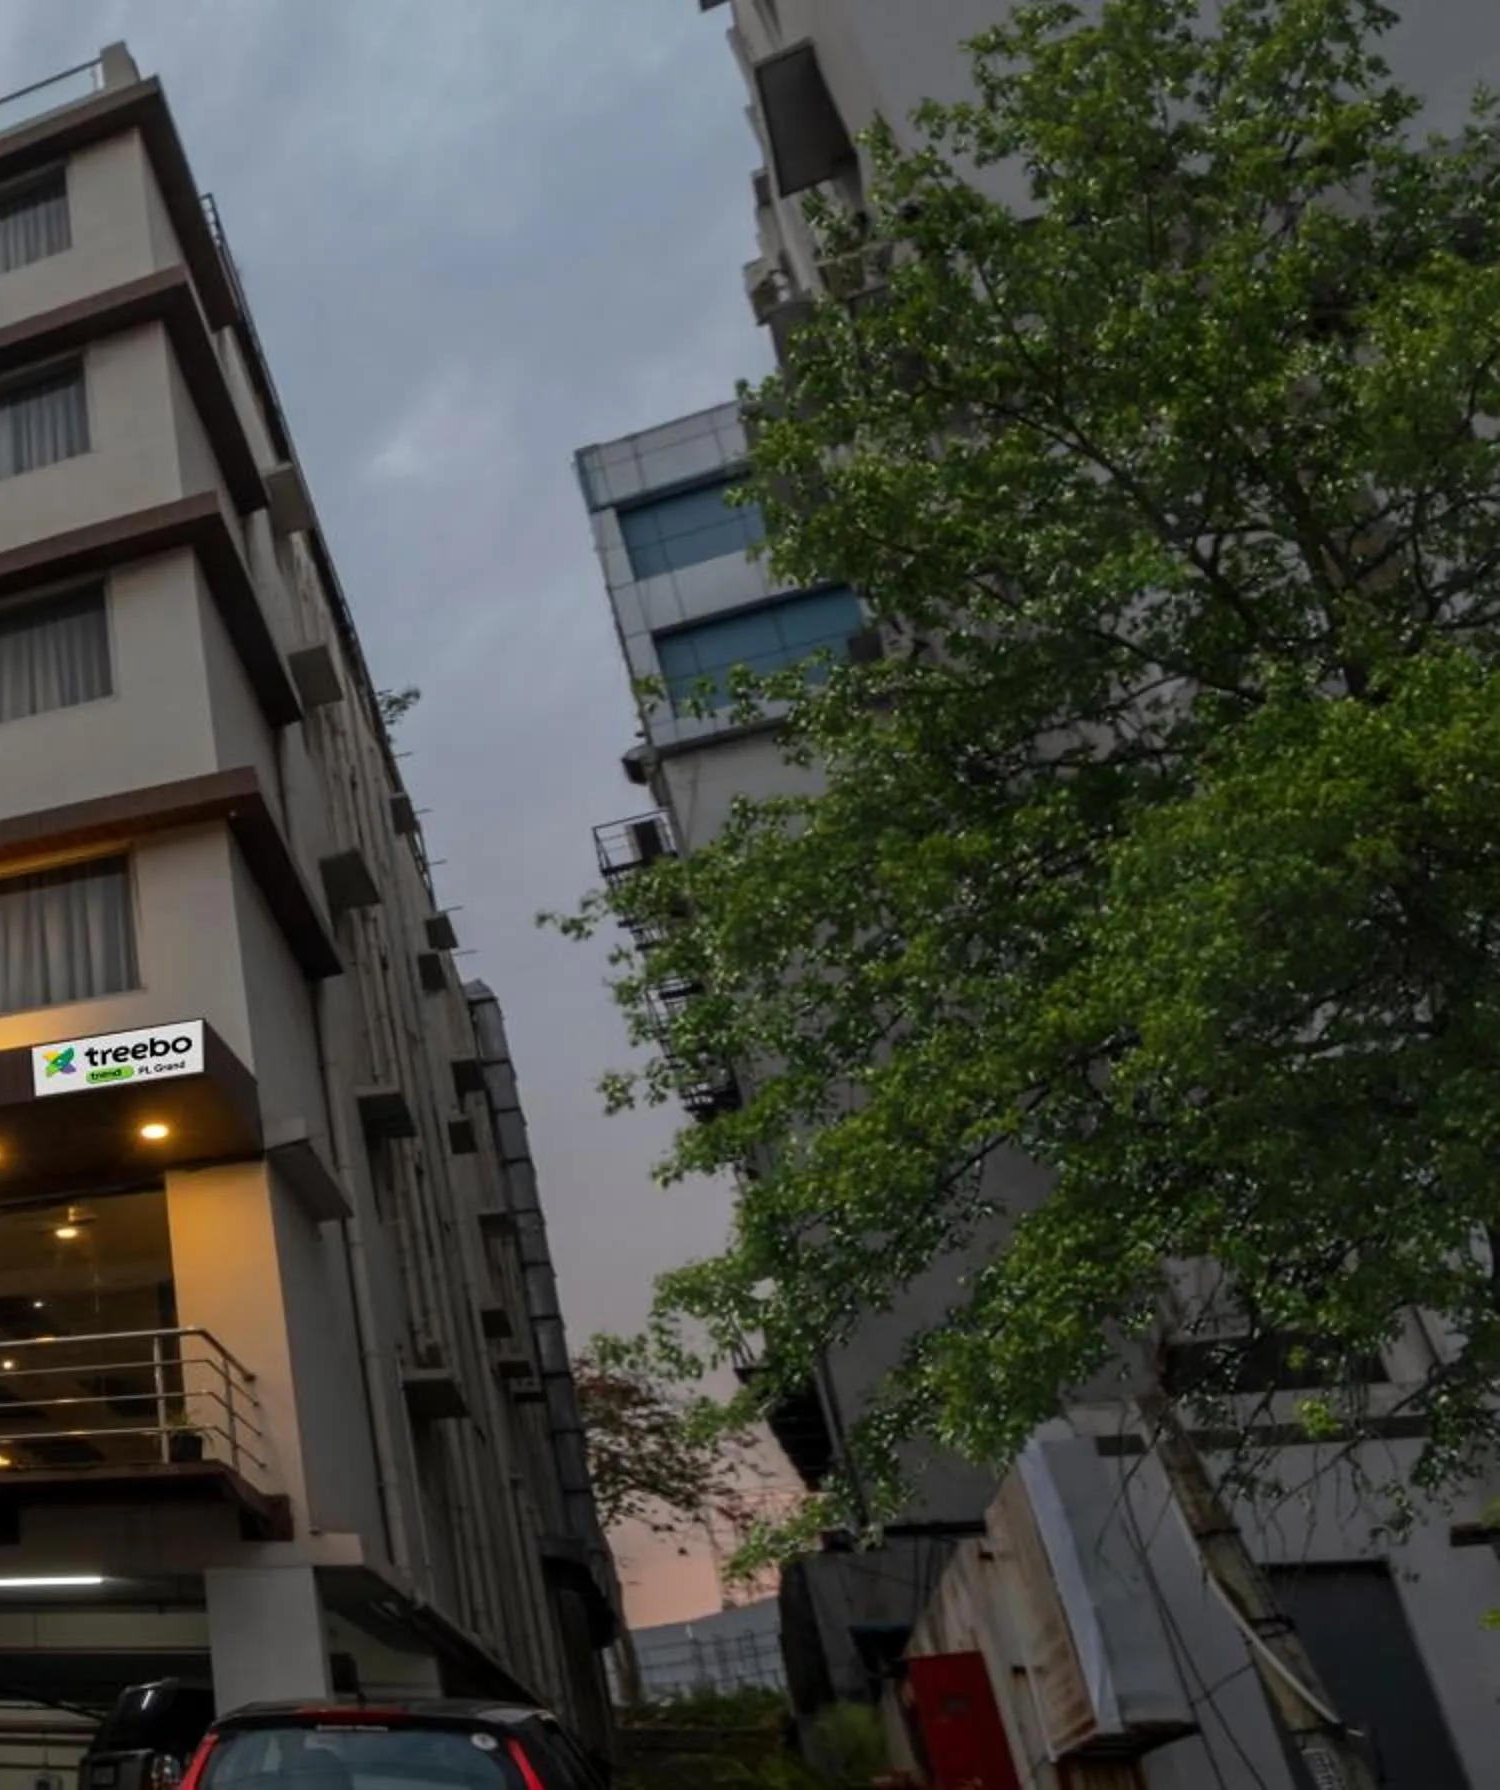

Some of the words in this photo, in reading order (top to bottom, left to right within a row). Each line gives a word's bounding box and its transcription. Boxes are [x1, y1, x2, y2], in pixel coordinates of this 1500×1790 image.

[85, 1036, 193, 1067] treebo
[138, 1066, 152, 1075] PL
[154, 1061, 186, 1073] Grand
